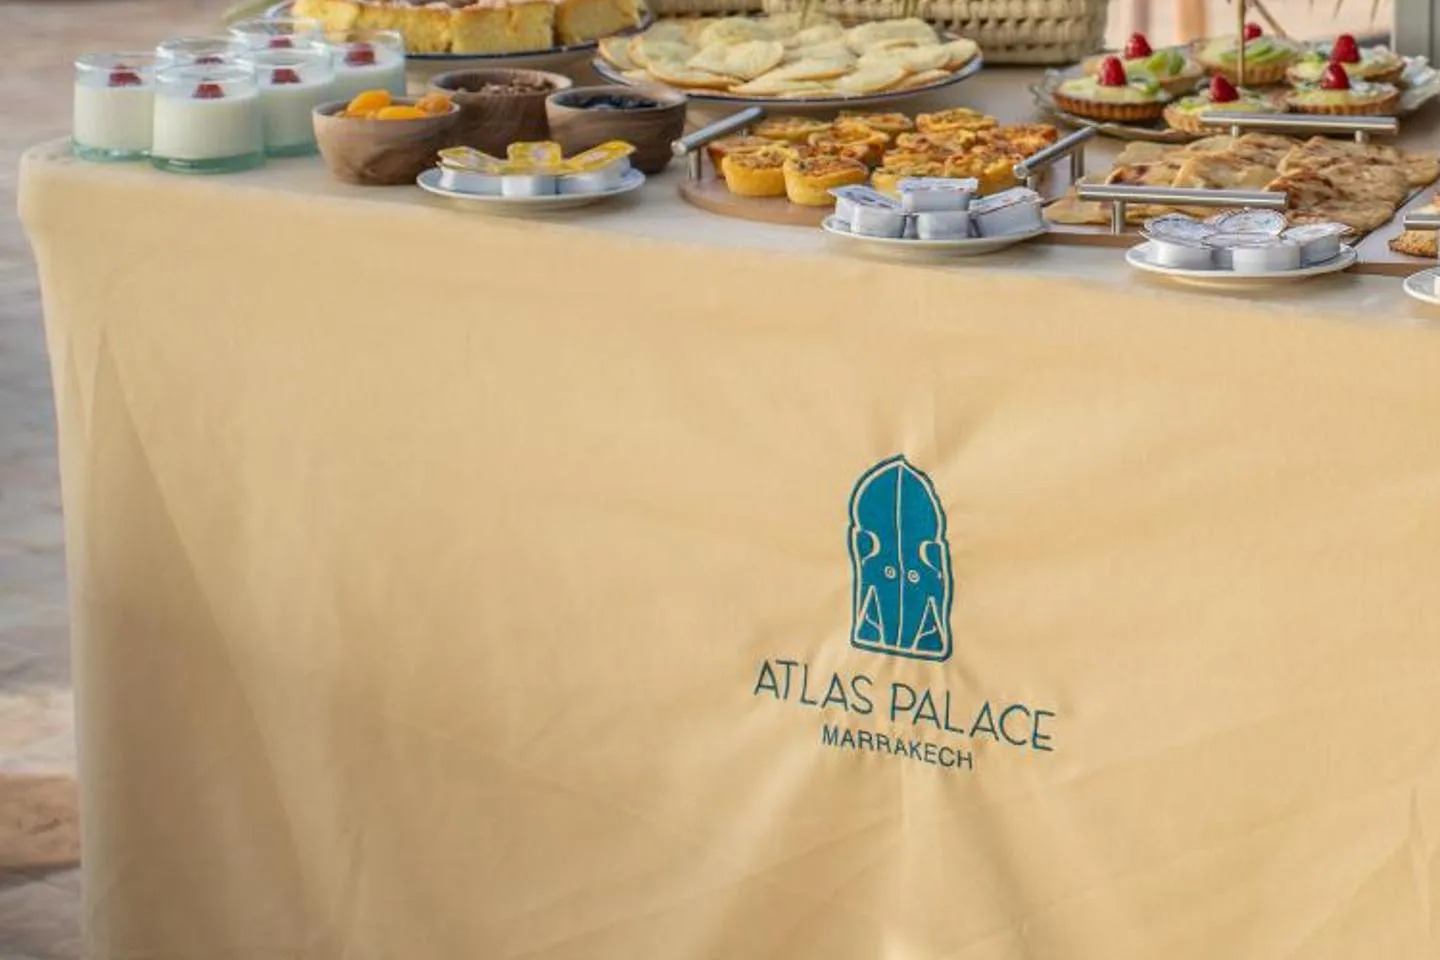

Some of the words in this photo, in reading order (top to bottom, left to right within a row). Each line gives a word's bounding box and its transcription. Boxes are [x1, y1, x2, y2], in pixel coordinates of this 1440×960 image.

[754, 659, 873, 715] ATLAS
[890, 681, 1056, 751] PALACE
[822, 724, 973, 770] MARRAKECH
